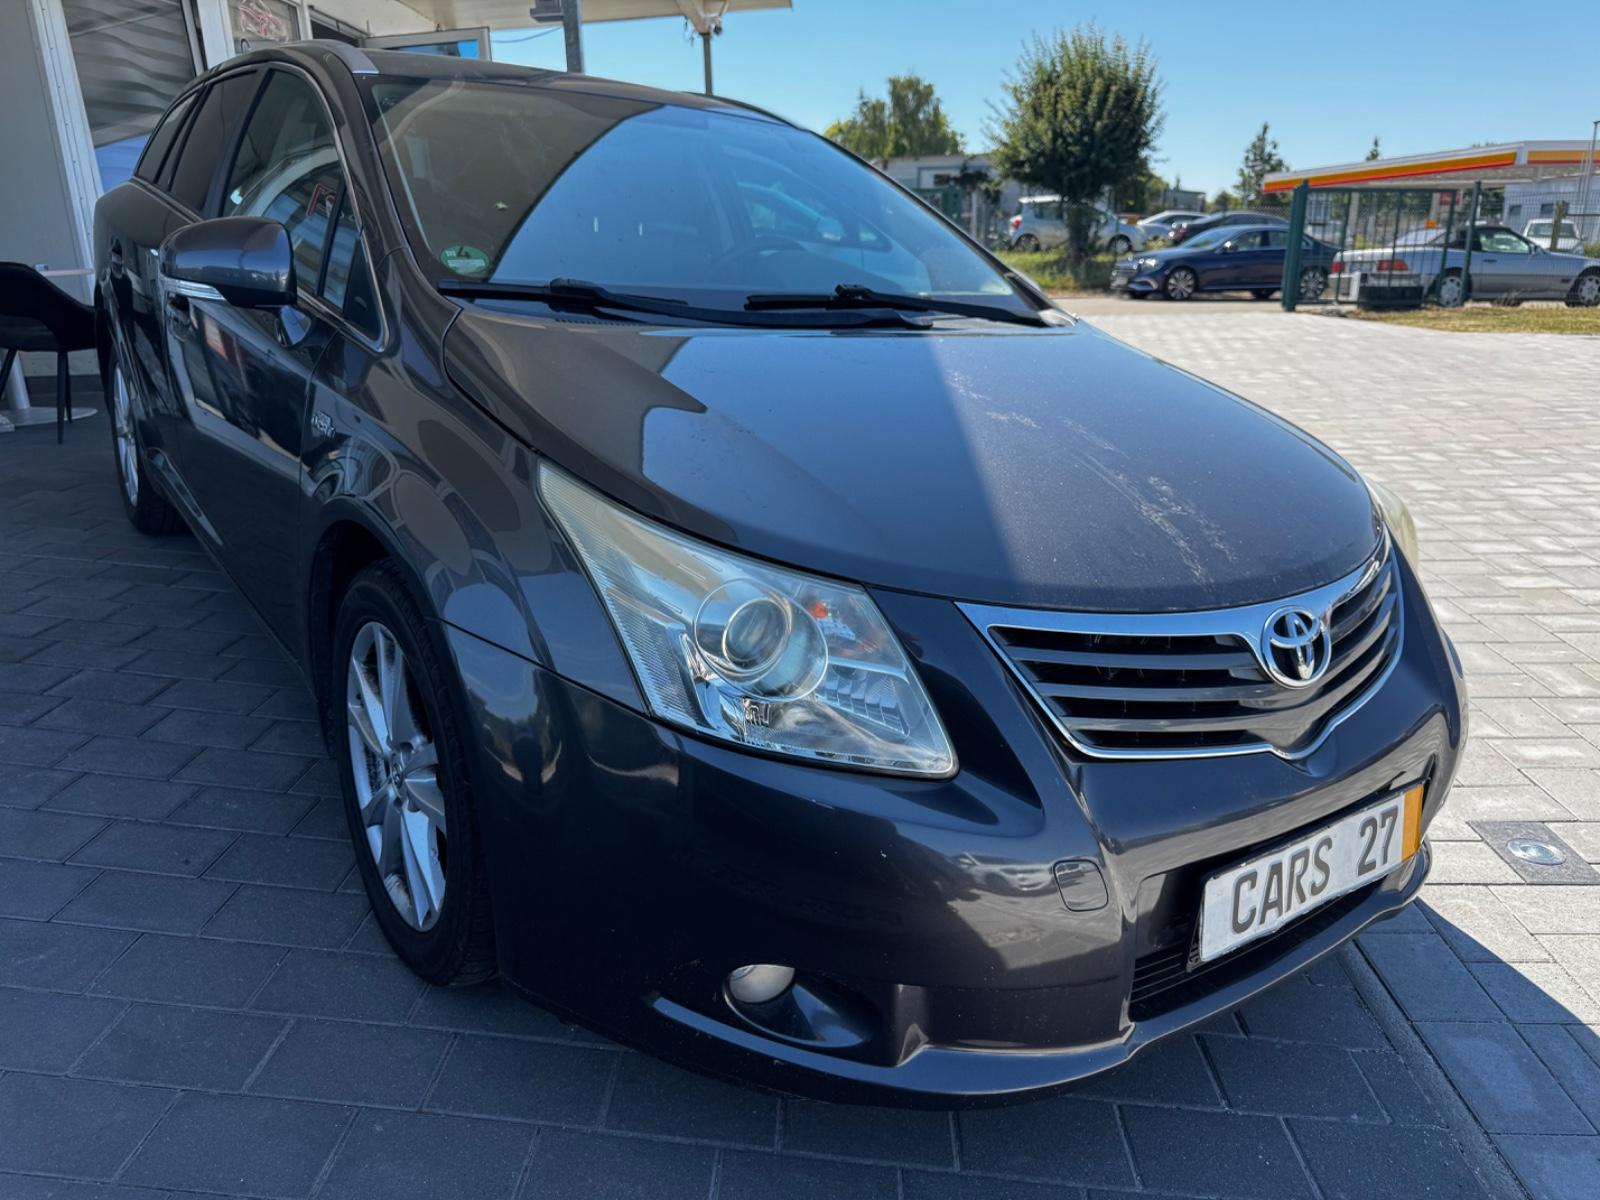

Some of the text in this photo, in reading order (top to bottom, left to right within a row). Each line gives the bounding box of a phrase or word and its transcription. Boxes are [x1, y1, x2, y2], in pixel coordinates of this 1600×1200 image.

[456, 246, 470, 259] 4
[1232, 805, 1399, 935] CARS 27
